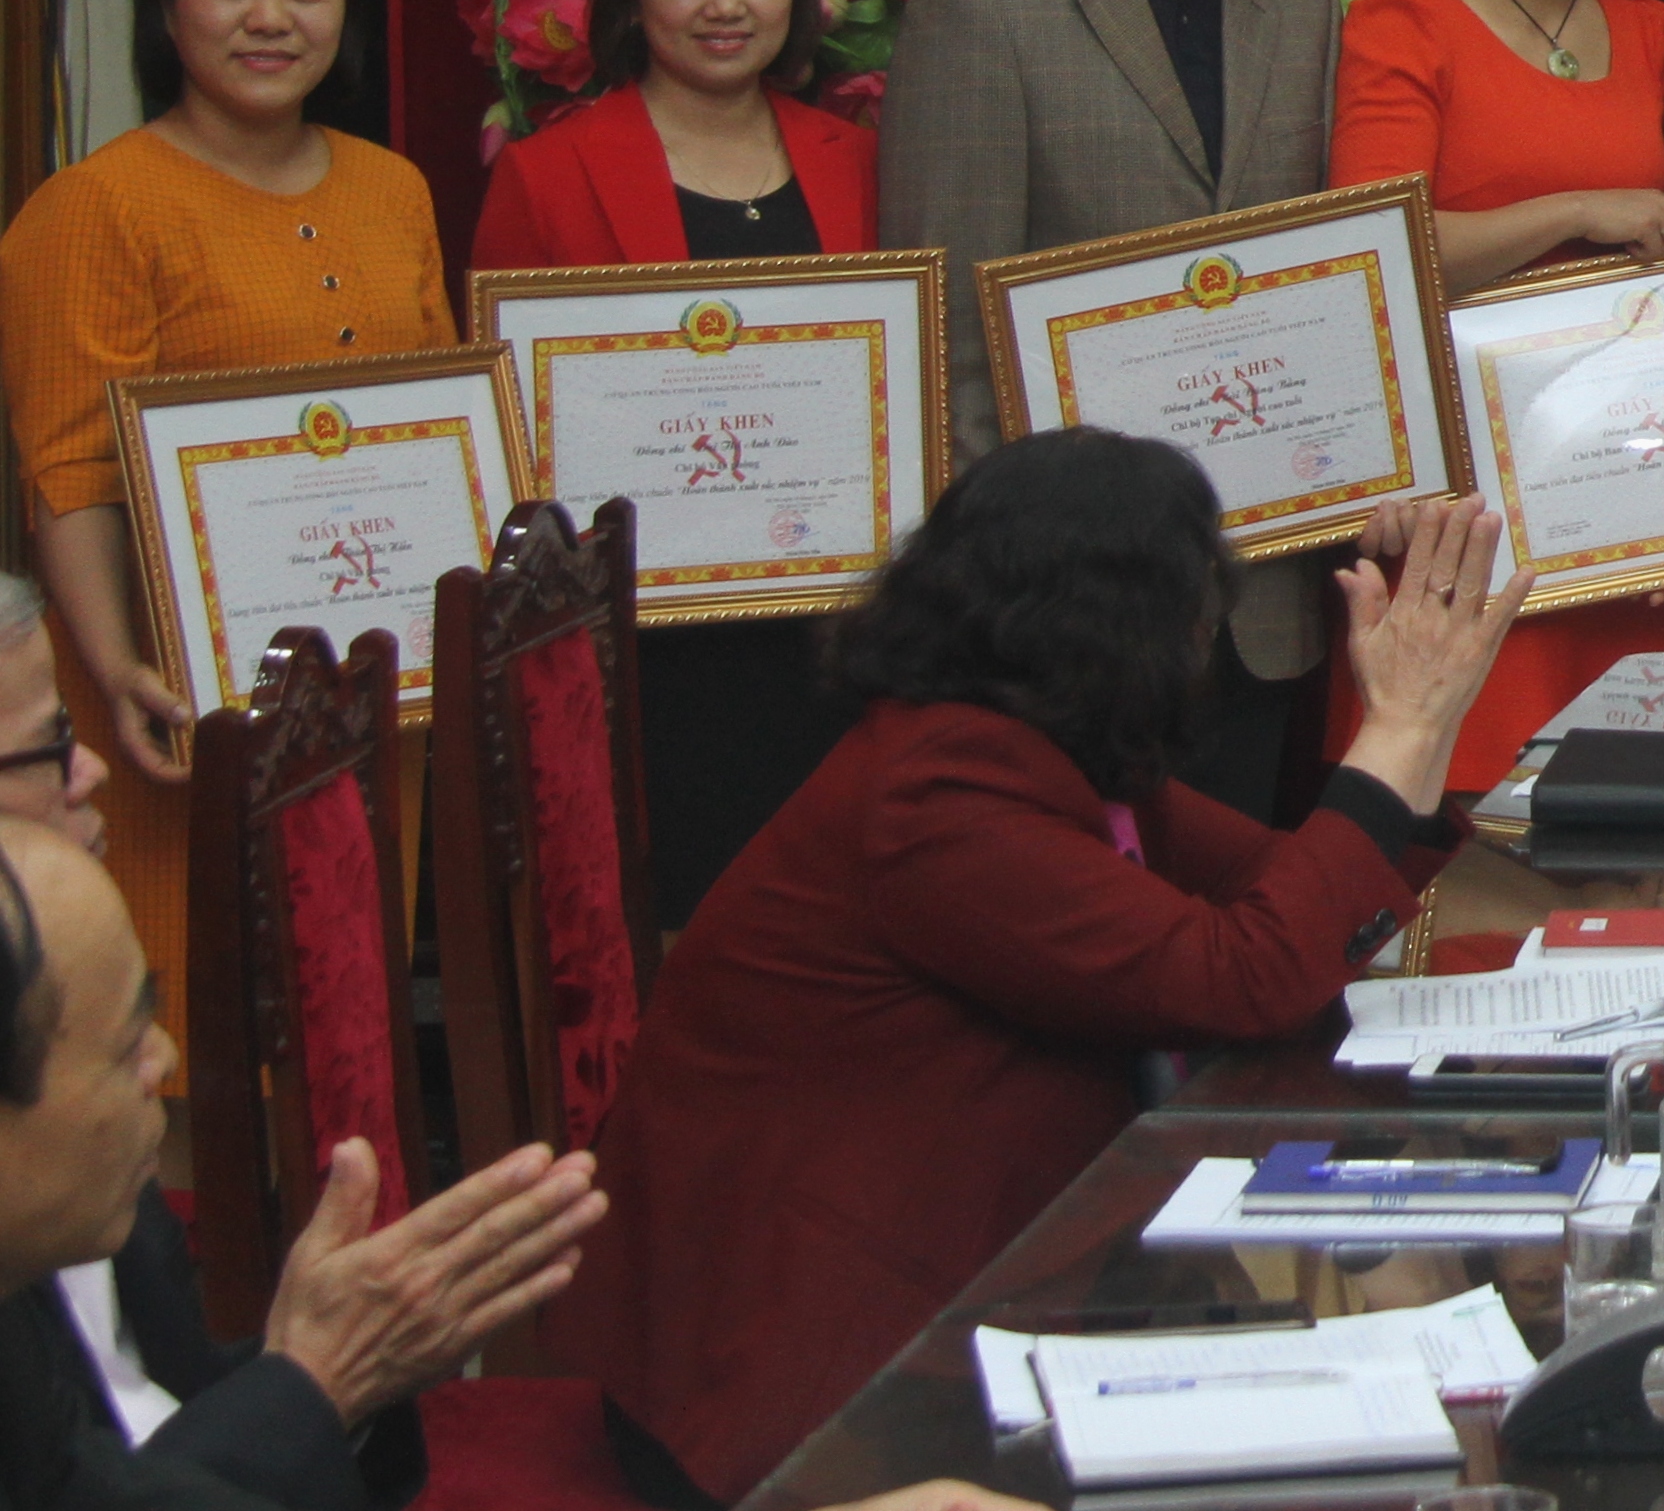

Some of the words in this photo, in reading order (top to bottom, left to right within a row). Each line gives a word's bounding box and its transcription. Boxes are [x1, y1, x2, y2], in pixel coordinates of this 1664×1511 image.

[1176, 364, 1225, 392] GIẤY
[1233, 355, 1288, 380] KHEN
[659, 411, 710, 435] GIẤY
[719, 412, 776, 432] KHEN
[299, 516, 341, 542] GIẤY
[349, 515, 397, 538] KHEN
